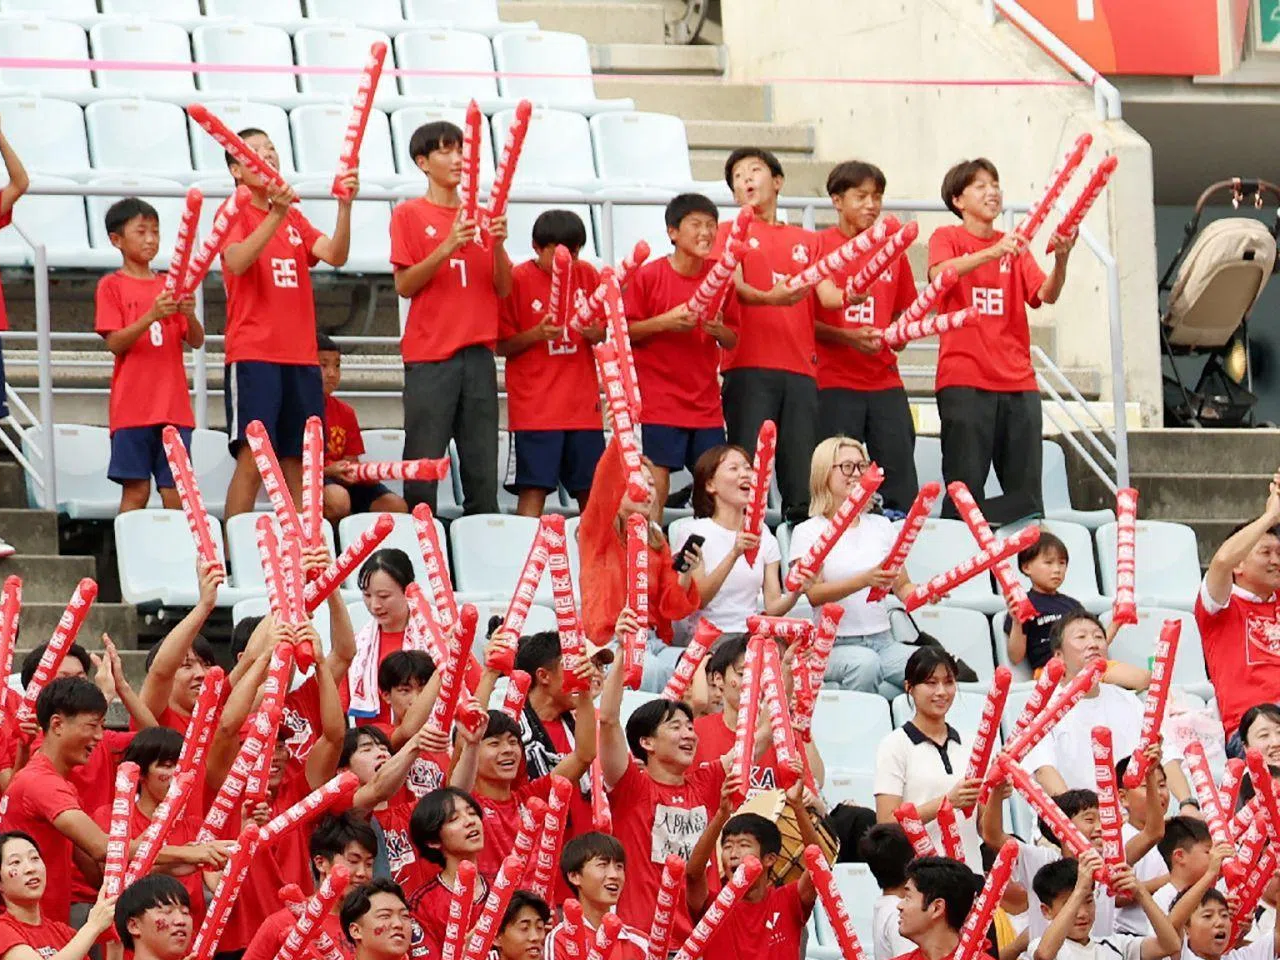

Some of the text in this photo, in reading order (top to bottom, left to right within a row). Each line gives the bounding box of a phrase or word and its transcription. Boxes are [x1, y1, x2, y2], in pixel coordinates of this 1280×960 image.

[450, 259, 467, 287] 7
[972, 287, 1003, 315] 66
[149, 320, 163, 346] 8
